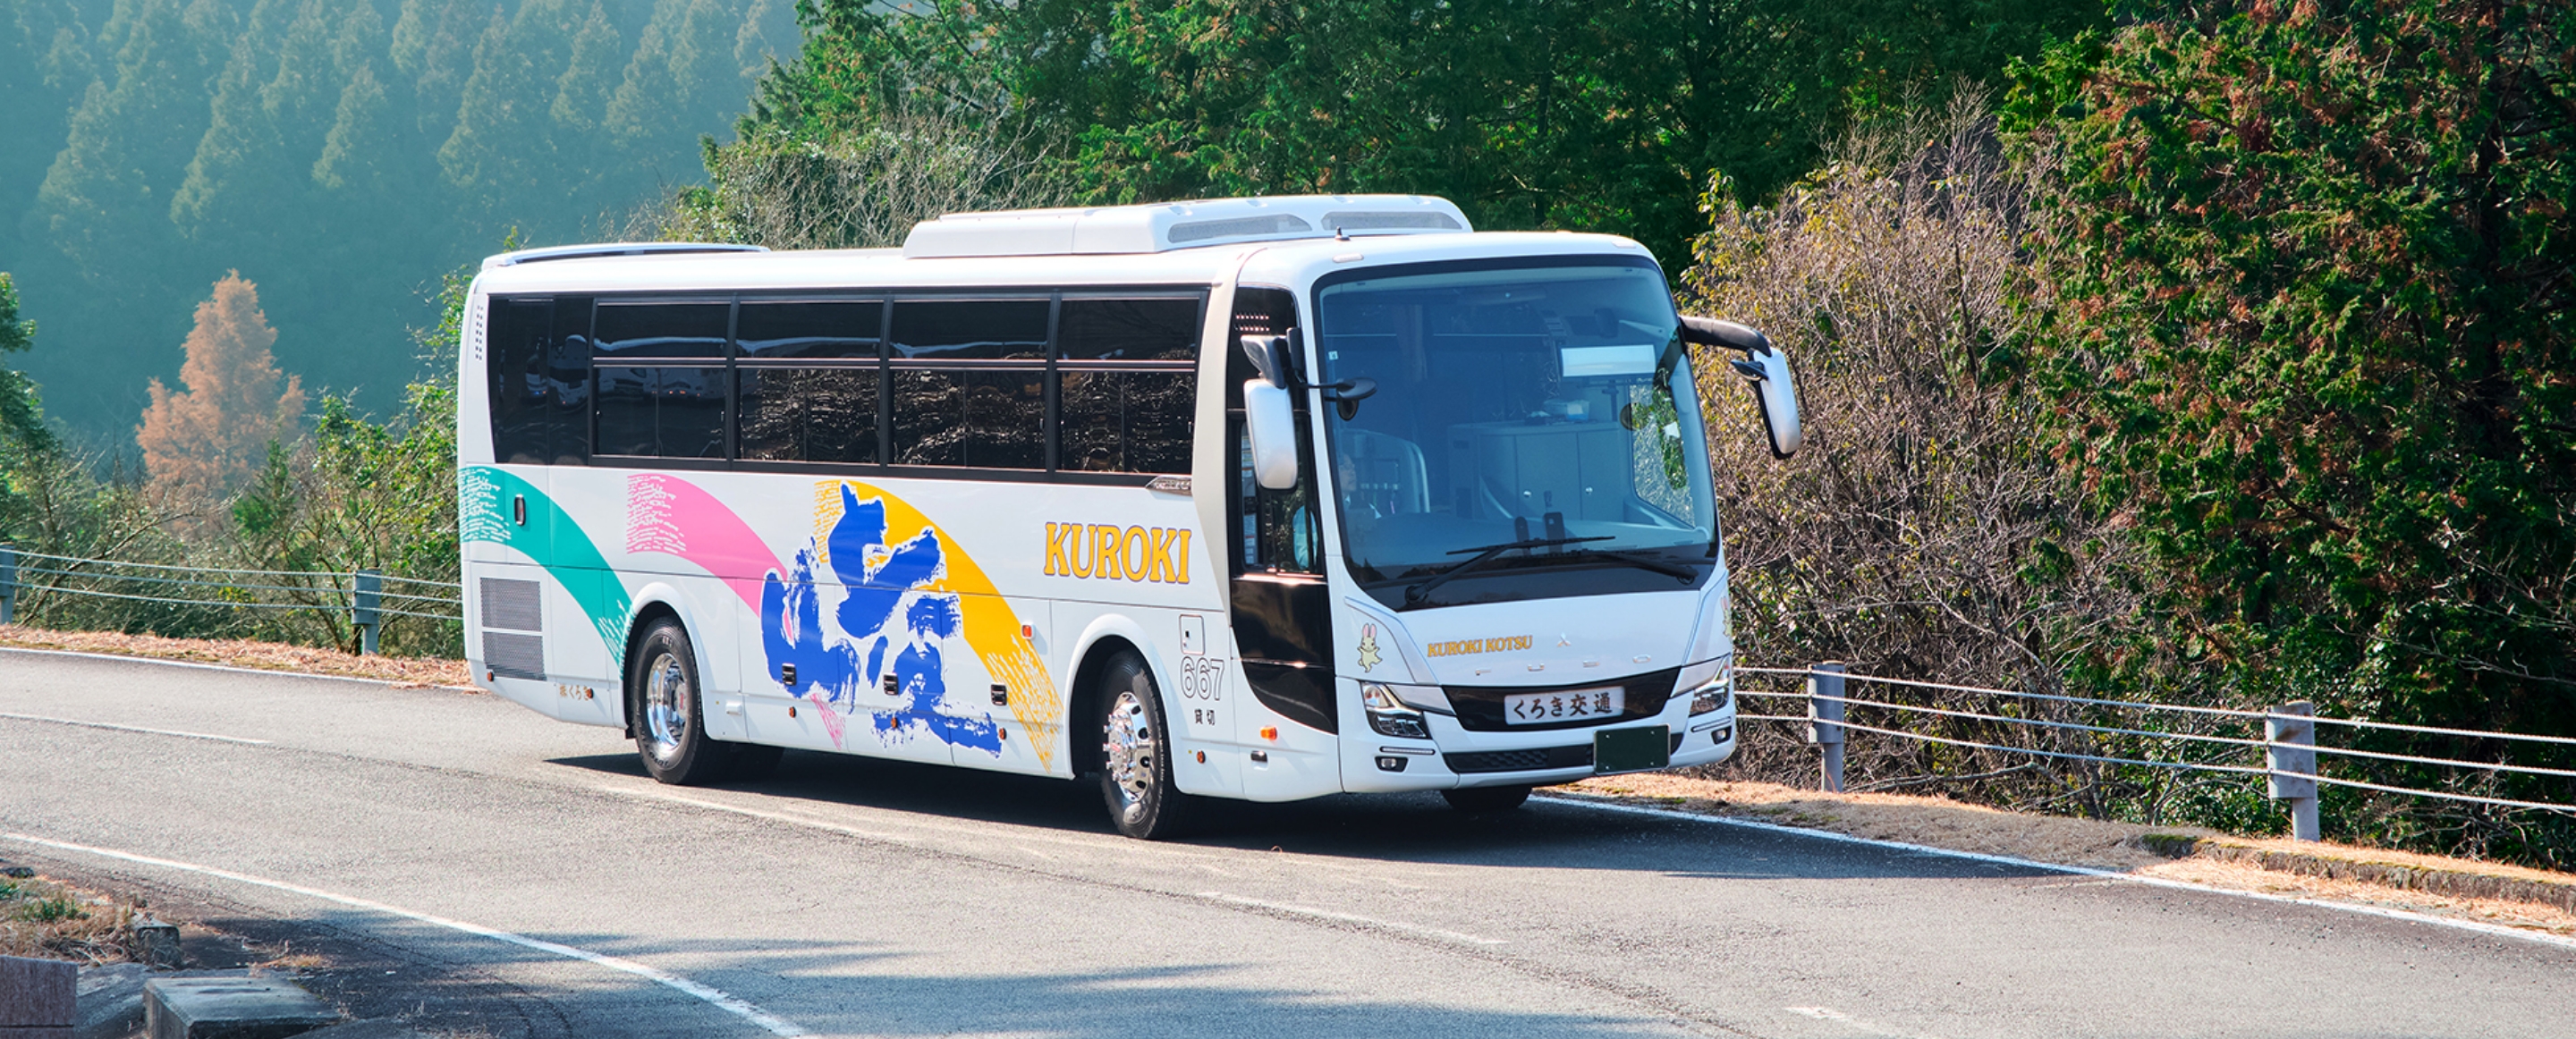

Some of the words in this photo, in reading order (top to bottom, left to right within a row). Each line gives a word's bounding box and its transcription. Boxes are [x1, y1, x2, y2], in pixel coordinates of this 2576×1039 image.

[1043, 521, 1192, 584] KUROKI
[1427, 639, 1483, 657] KUROKI
[1485, 634, 1533, 653] KOTSU
[1181, 655, 1225, 701] 667
[1194, 708, 1216, 726] 貸切
[1513, 691, 1613, 720] くろき交通
